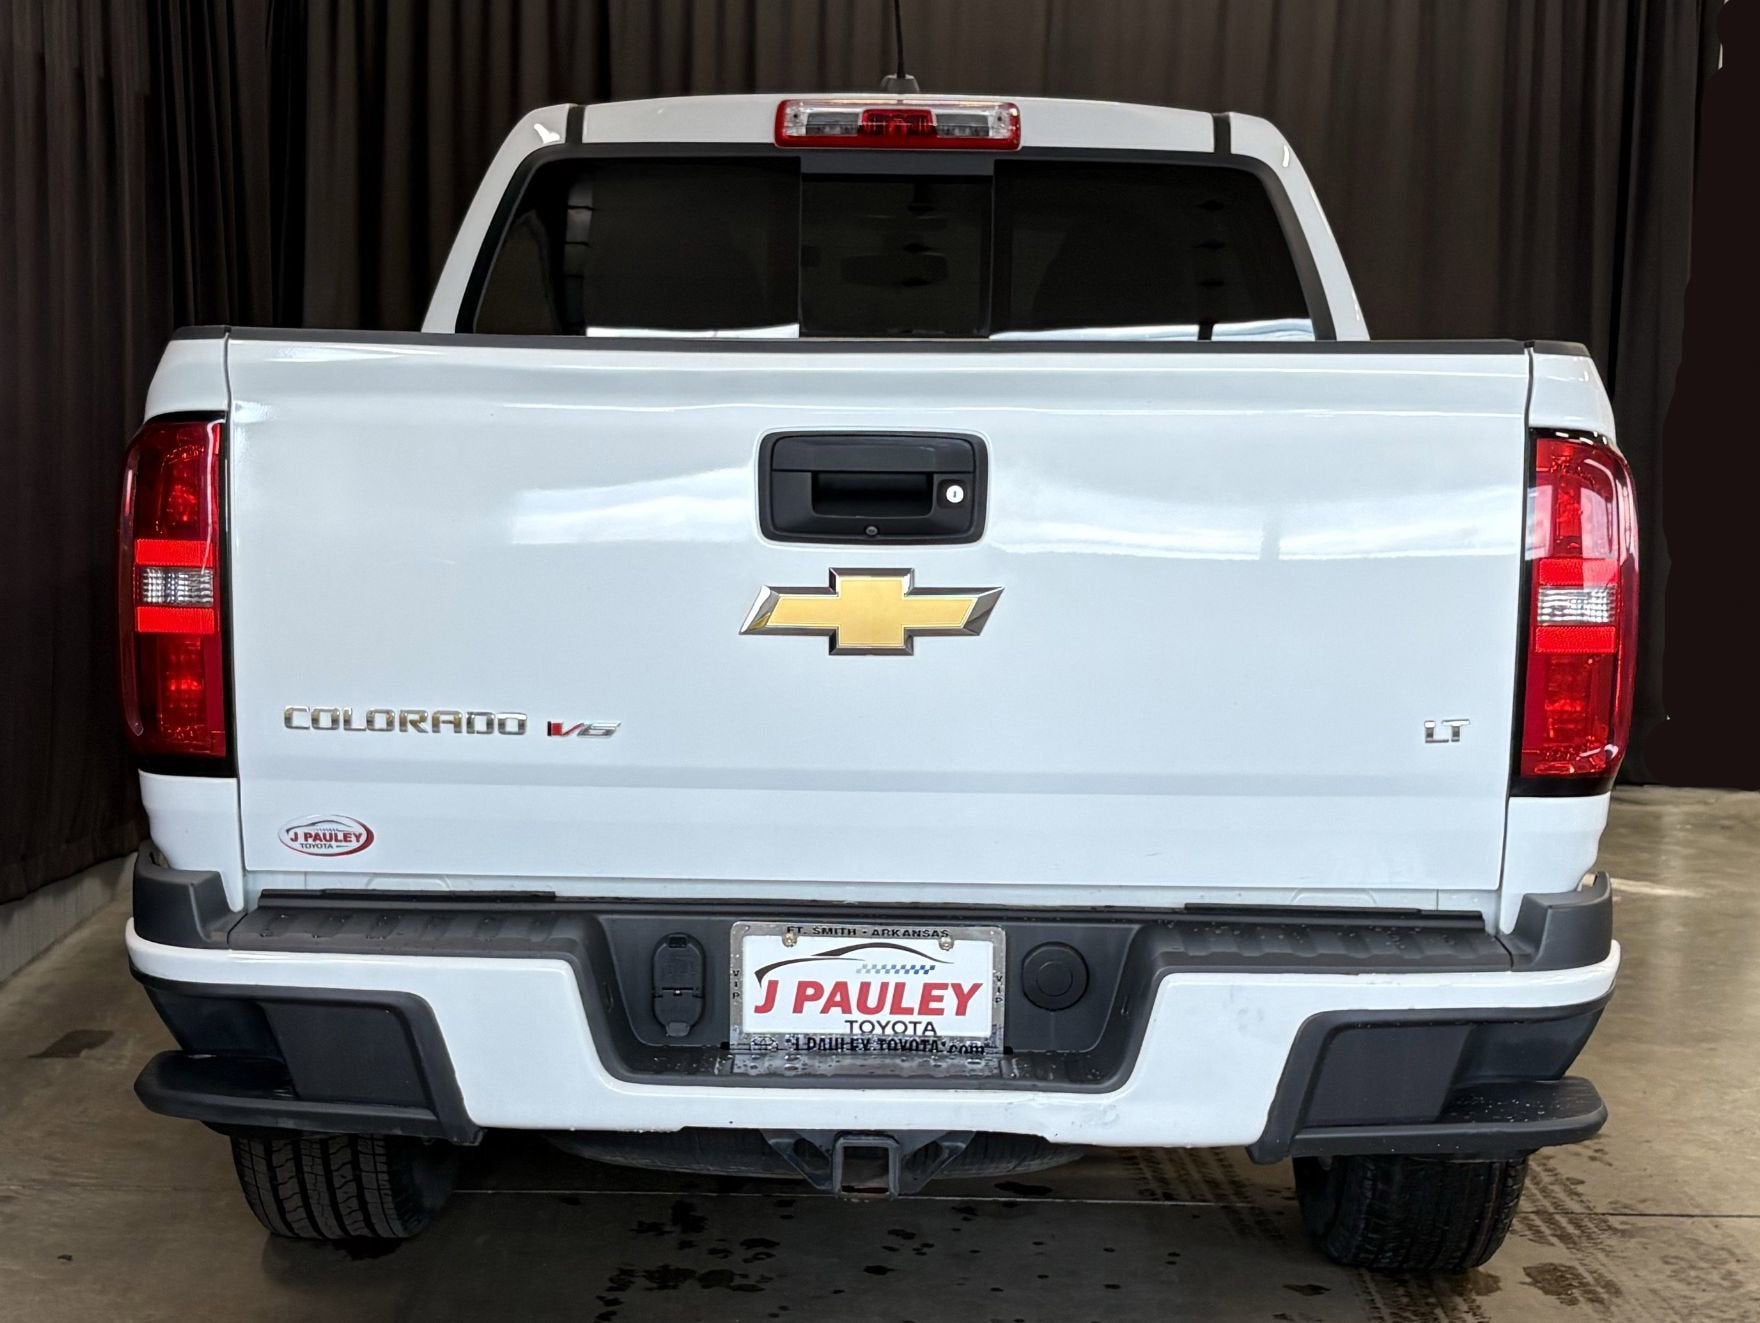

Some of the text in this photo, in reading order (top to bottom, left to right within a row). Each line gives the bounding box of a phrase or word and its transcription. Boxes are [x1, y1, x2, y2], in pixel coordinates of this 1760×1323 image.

[283, 705, 528, 736] COLORADO
[546, 719, 622, 739] V6
[1424, 718, 1471, 743] LT
[289, 831, 362, 843] J PAULEY
[300, 842, 335, 850] TOYOTA
[812, 925, 857, 937] SMITH
[871, 927, 950, 938] ARKANSAS
[754, 979, 984, 1017] J PAULEY
[844, 1019, 938, 1036] TOYOTA
